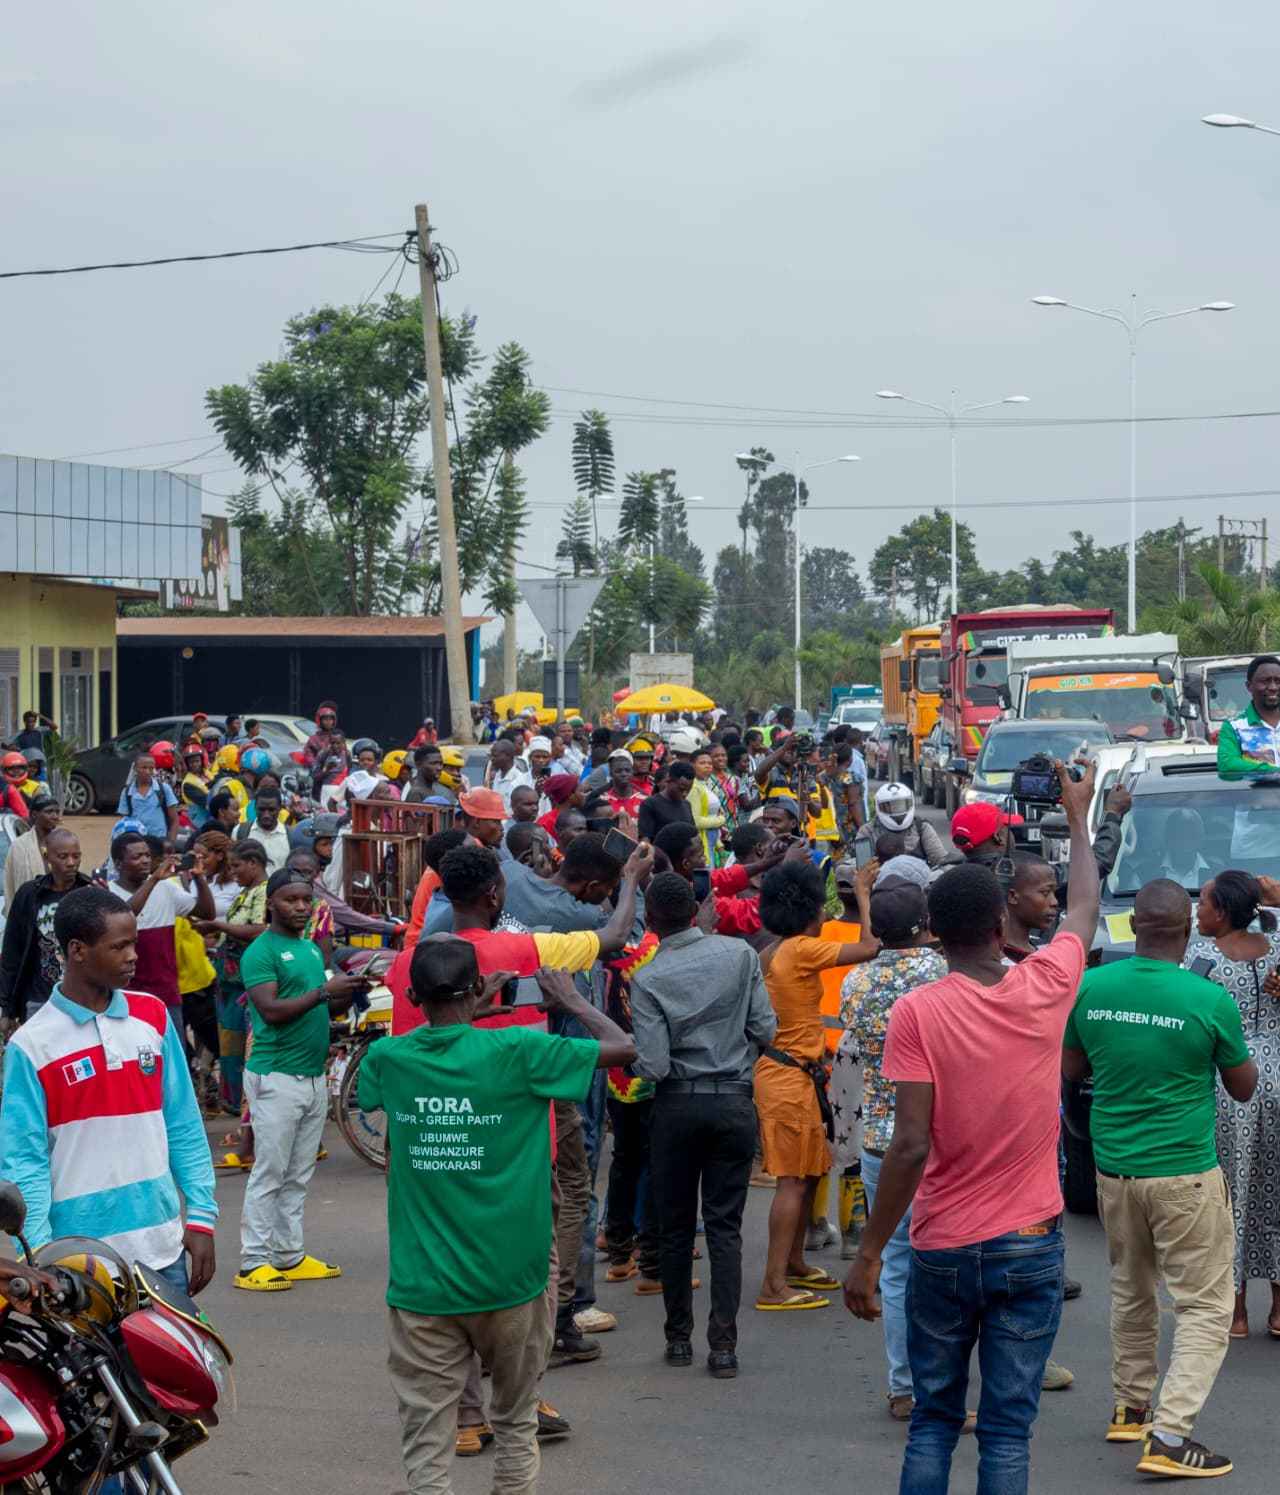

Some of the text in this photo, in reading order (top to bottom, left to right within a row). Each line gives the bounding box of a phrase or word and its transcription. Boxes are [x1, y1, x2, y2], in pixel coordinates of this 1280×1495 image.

[1087, 1009, 1184, 1031] DGPR-GREEN PARTY
[414, 1097, 474, 1113] TORA
[426, 1115, 464, 1125] GREEN
[467, 1114, 502, 1125] PARTY
[420, 1133, 469, 1143] UBUMWE
[409, 1145, 485, 1156] UBWISANZURE
[412, 1160, 481, 1170] DEMOKARASI
